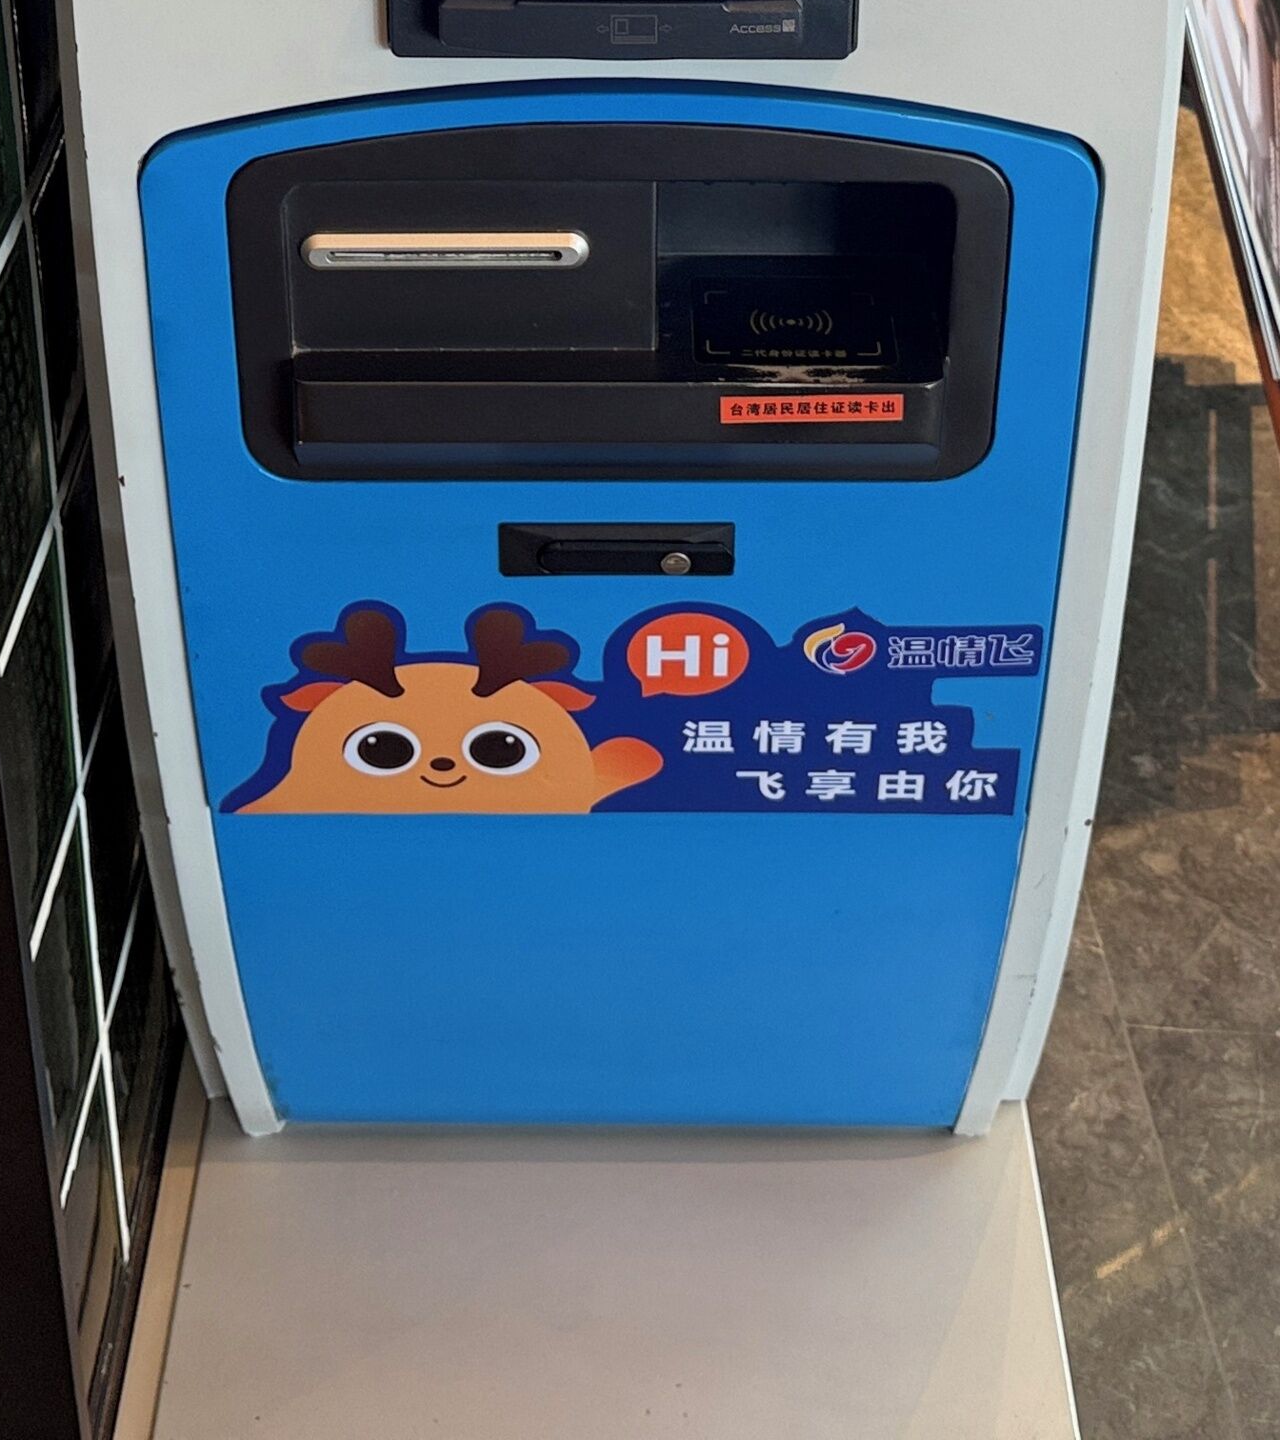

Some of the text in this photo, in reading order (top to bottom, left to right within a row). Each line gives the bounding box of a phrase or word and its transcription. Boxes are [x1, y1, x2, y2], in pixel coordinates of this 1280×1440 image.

[729, 22, 782, 35] Access
[645, 632, 730, 678] Hi
[887, 633, 1036, 670] 温情飞
[681, 719, 950, 755] 温情有我
[735, 769, 1000, 803] 飞享由你
